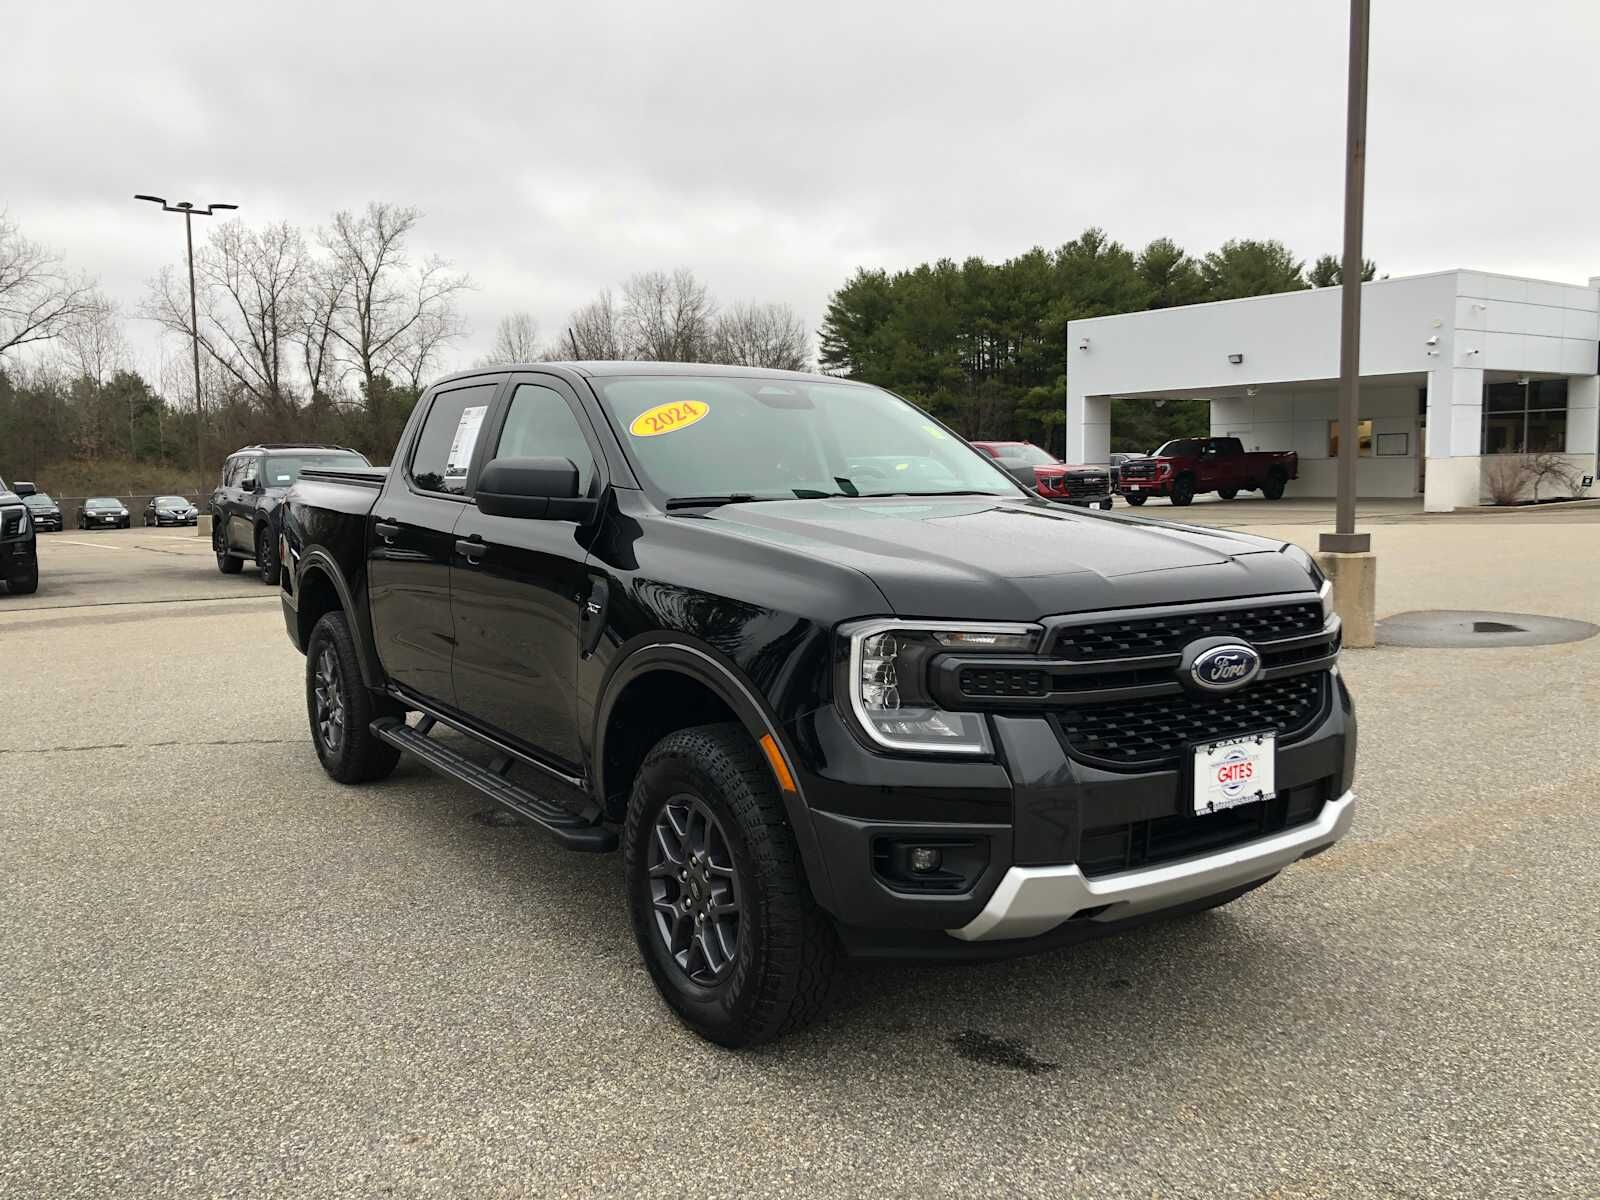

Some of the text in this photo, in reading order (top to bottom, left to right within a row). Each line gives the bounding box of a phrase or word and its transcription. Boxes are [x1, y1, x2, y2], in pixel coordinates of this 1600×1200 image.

[645, 403, 699, 431] 2024
[1211, 655, 1247, 680] Ford
[1217, 762, 1253, 783] GATES
